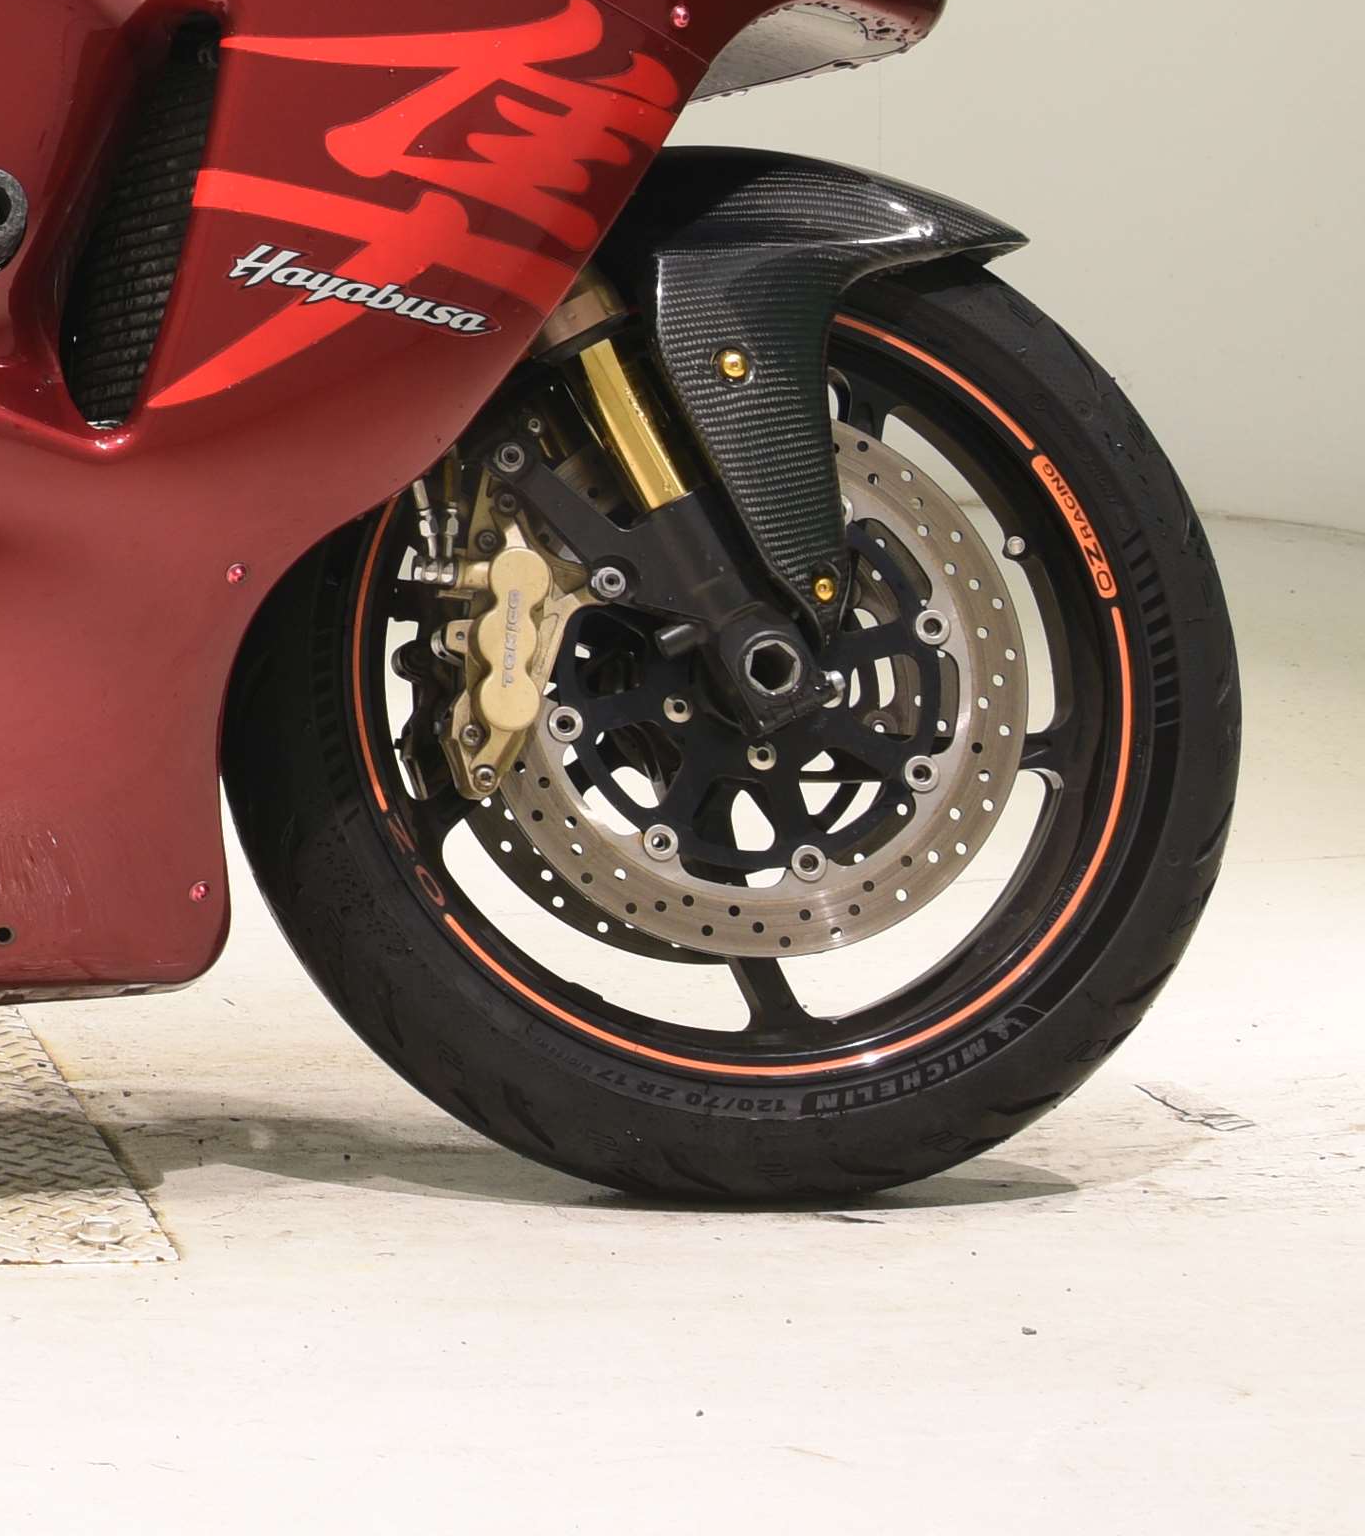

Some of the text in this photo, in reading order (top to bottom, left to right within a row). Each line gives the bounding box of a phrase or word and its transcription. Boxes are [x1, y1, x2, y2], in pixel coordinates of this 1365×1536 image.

[232, 243, 491, 336] Hayabusa
[1041, 462, 1092, 539] RACING
[595, 1067, 627, 1085] 17
[634, 1079, 676, 1099] ZR
[813, 1036, 987, 1109] MICHELIN
[683, 1090, 786, 1112] 120/70
